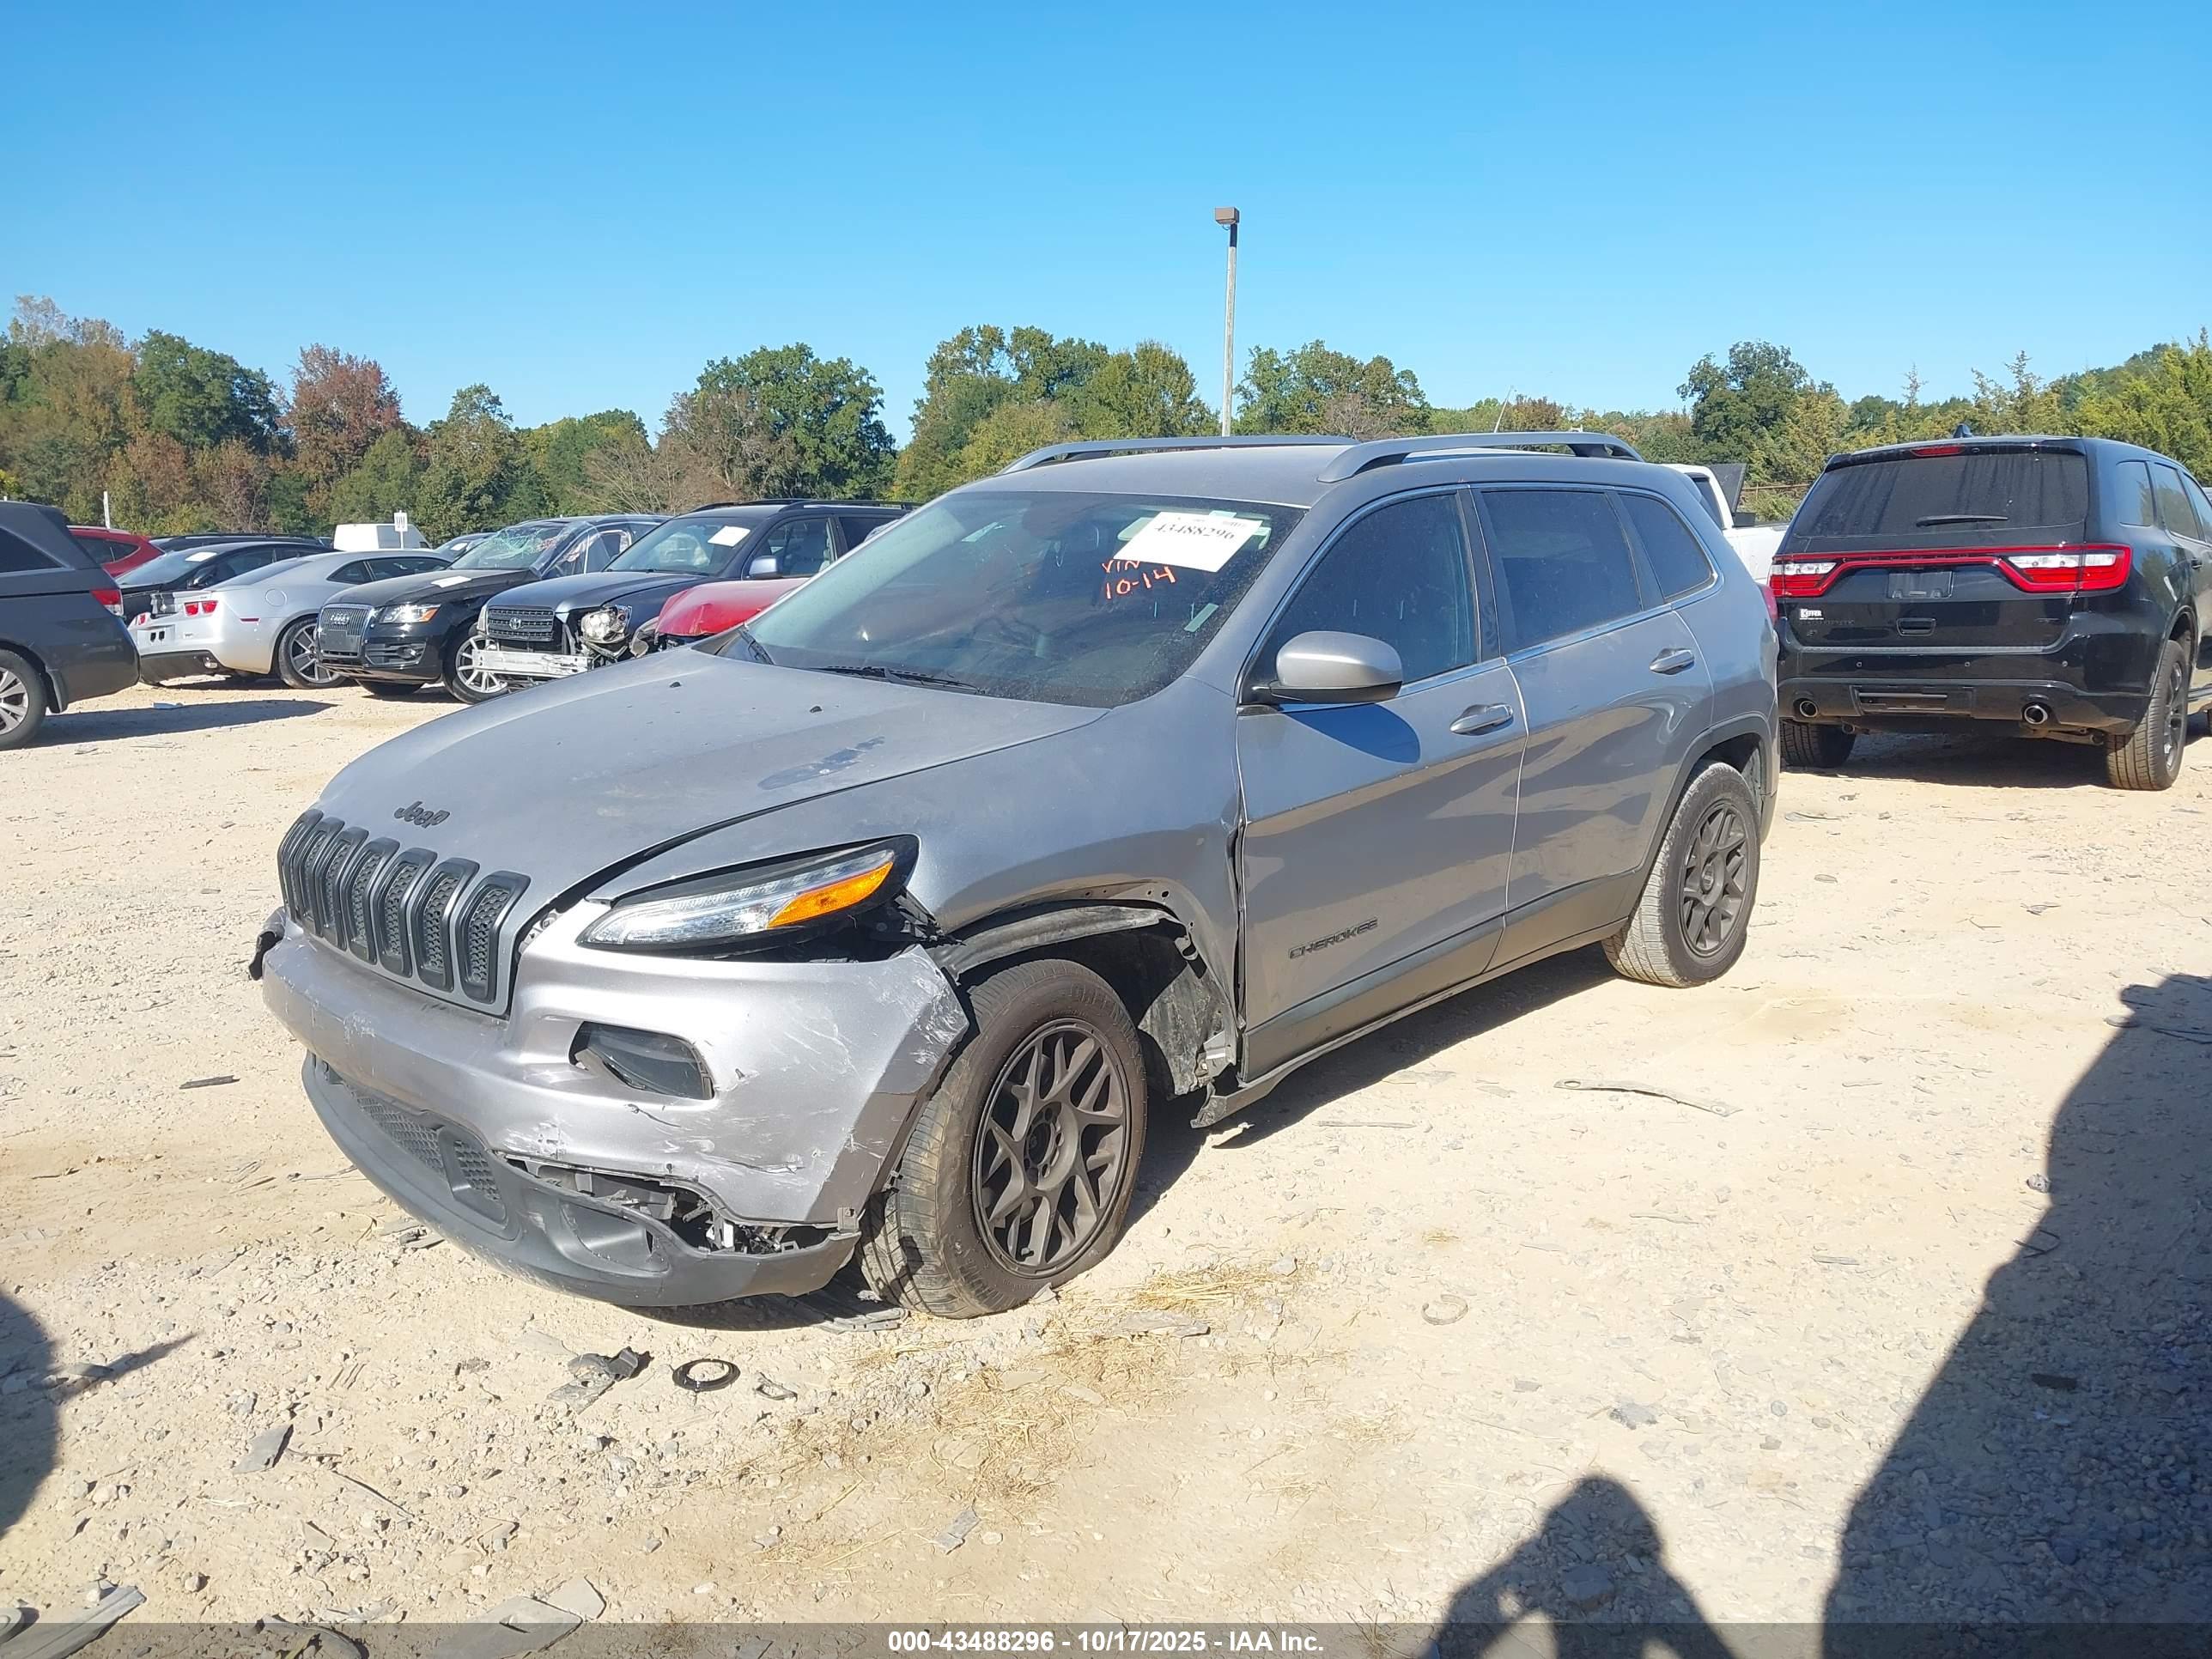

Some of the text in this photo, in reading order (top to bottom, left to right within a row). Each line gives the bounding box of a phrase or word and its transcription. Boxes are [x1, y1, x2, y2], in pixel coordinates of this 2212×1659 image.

[1102, 560, 1139, 574] VIN
[1106, 566, 1176, 599] 10-14
[393, 800, 451, 829] Jeep
[1289, 918, 1378, 958] CHEROKEE
